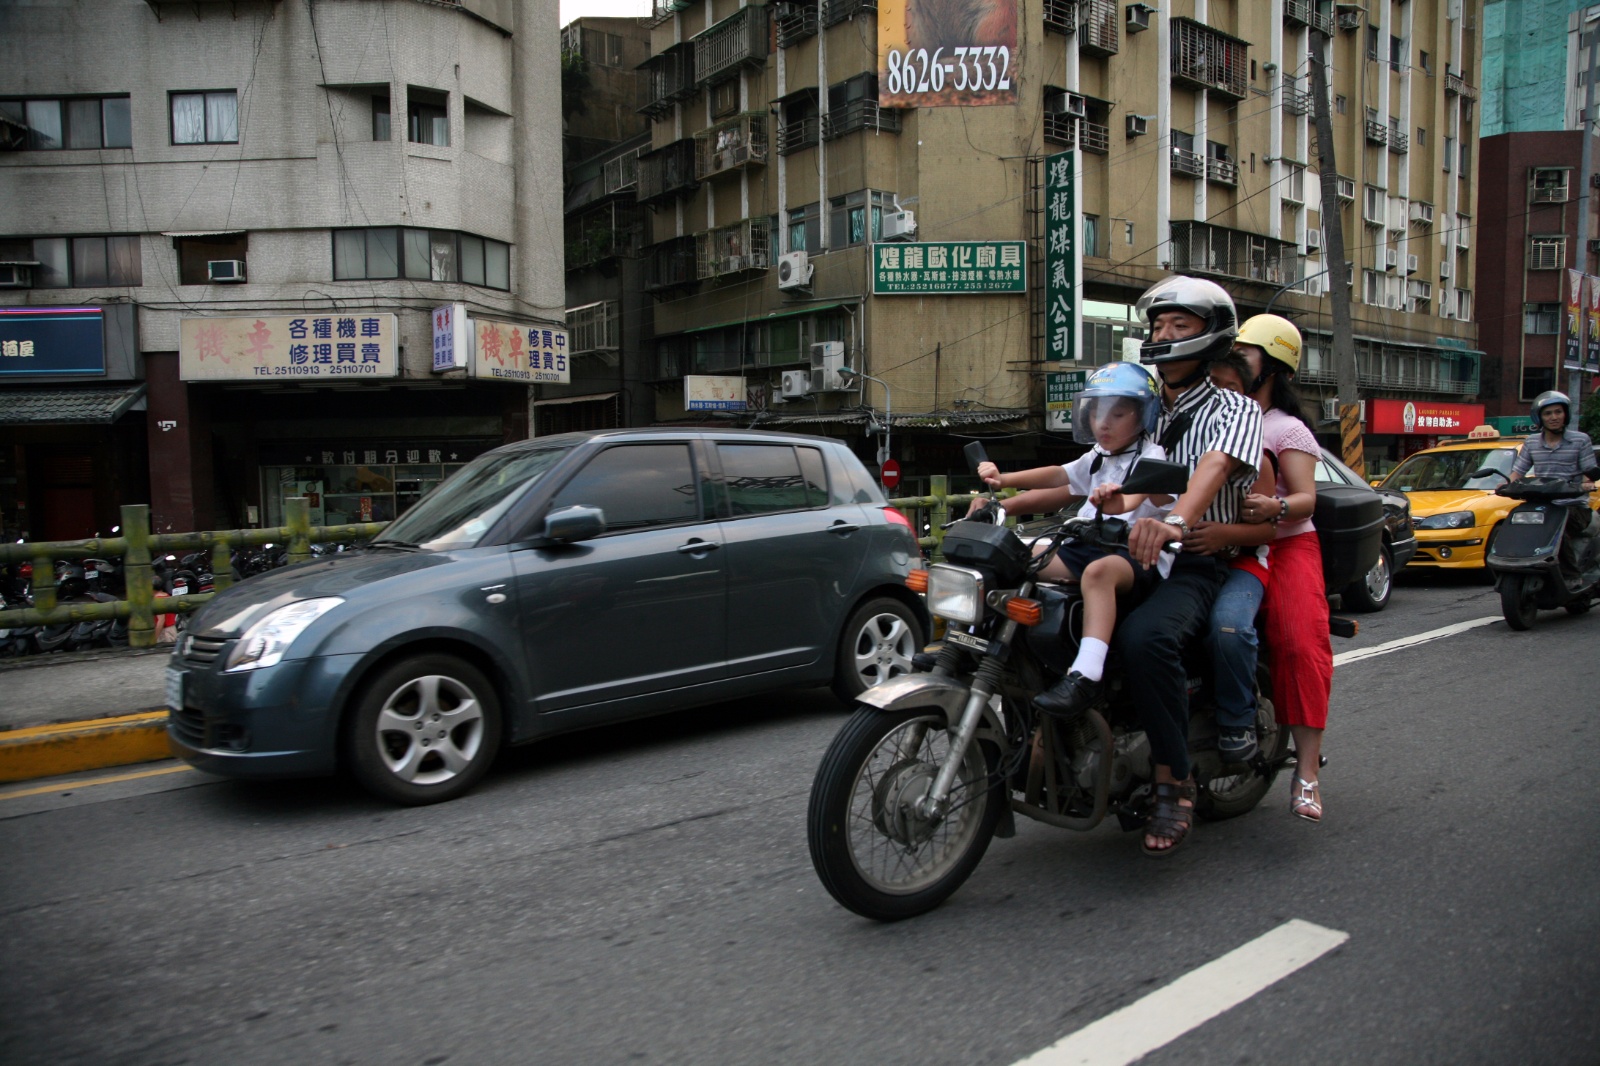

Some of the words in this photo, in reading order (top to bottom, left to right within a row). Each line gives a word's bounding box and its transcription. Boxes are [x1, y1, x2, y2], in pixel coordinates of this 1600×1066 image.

[888, 45, 1010, 94] 8626-3332
[880, 246, 1020, 269] 煌龍歐化廚具
[1049, 157, 1071, 357] 煌龍煤氣公司
[289, 318, 381, 339] 各種機車
[0, 340, 35, 357] 酒屋
[194, 320, 274, 364] 機車
[289, 343, 381, 364] 修理買賣
[481, 324, 524, 369] 機車
[254, 366, 320, 375] TEL:25110913
[330, 365, 376, 374] 25110701
